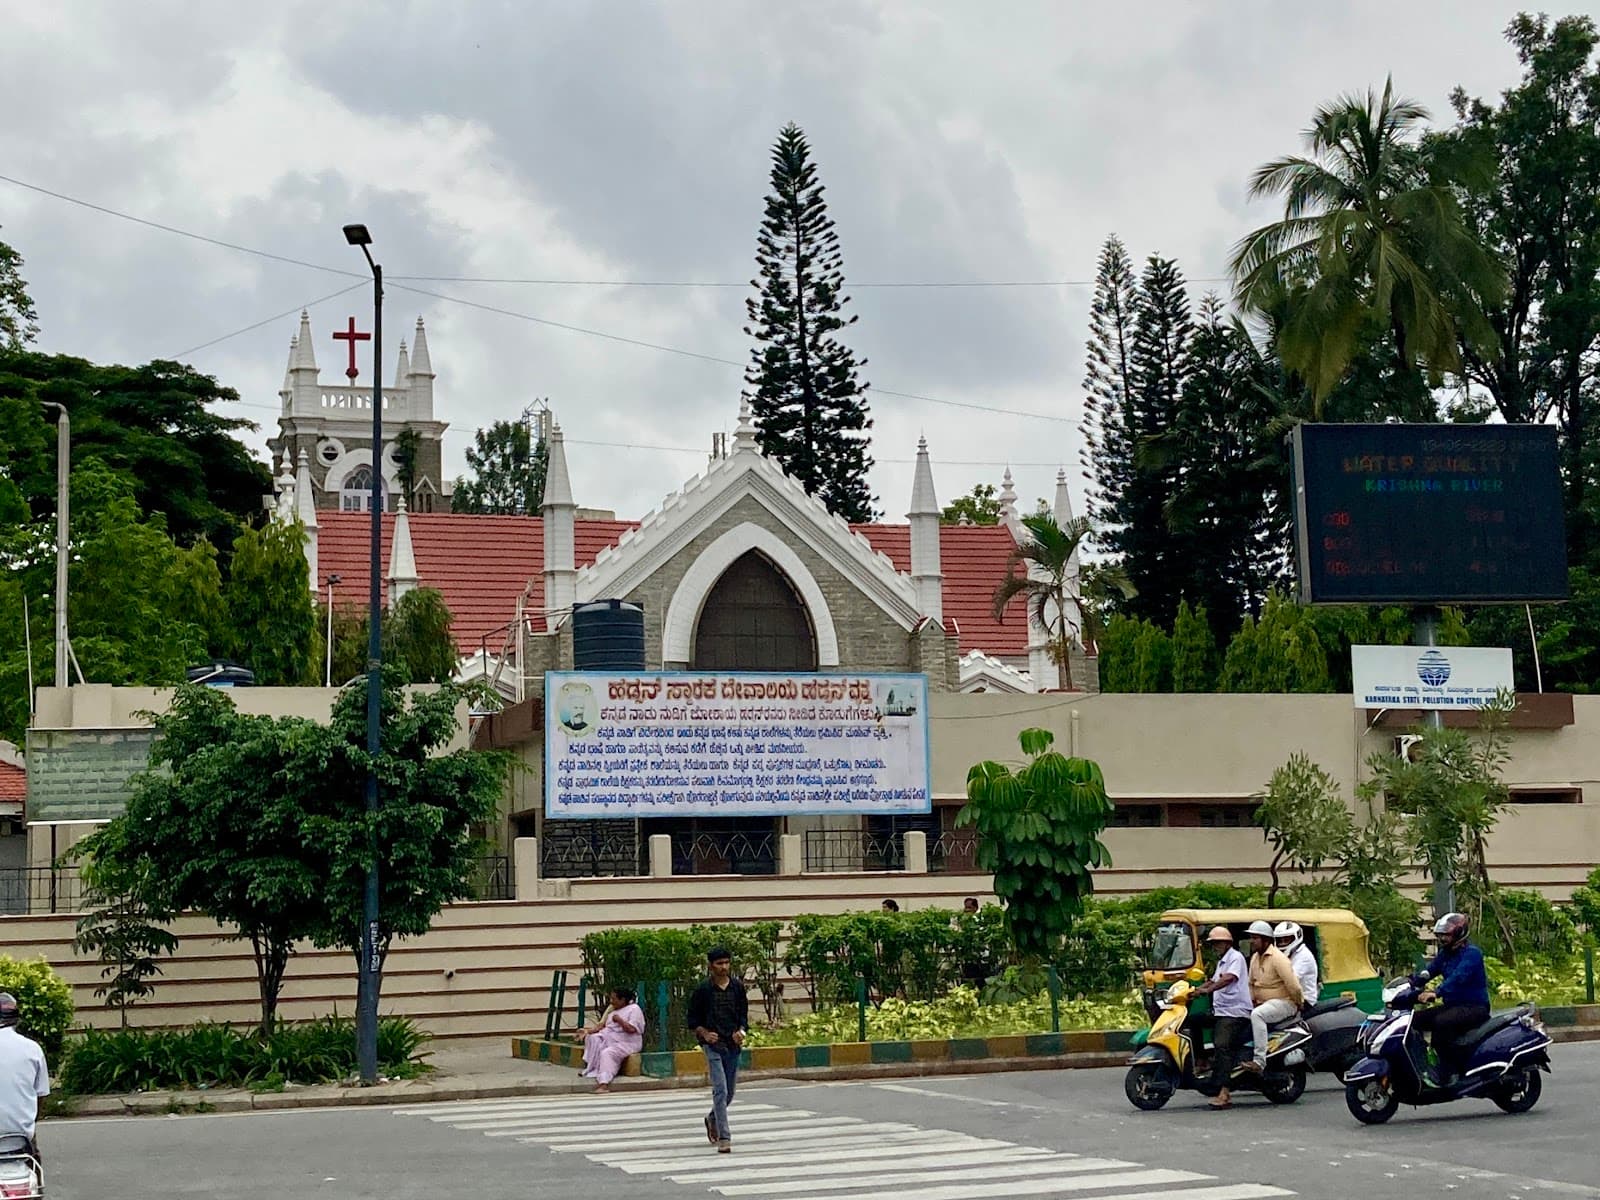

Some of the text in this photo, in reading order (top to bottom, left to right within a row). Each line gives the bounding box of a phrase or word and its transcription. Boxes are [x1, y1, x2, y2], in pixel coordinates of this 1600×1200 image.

[608, 678, 662, 704] ಹಡ್ಸನ್
[667, 679, 716, 704] ಸ್ಮಾರಕ
[721, 678, 798, 700] ದೇವಾಲಯ
[1402, 696, 1420, 704] STATE
[1422, 696, 1454, 704] POLLUTION
[601, 706, 626, 723] ಕನ್ನಡ
[629, 708, 657, 720] ನಾಡು
[789, 706, 816, 720] ನೀಡಿದ
